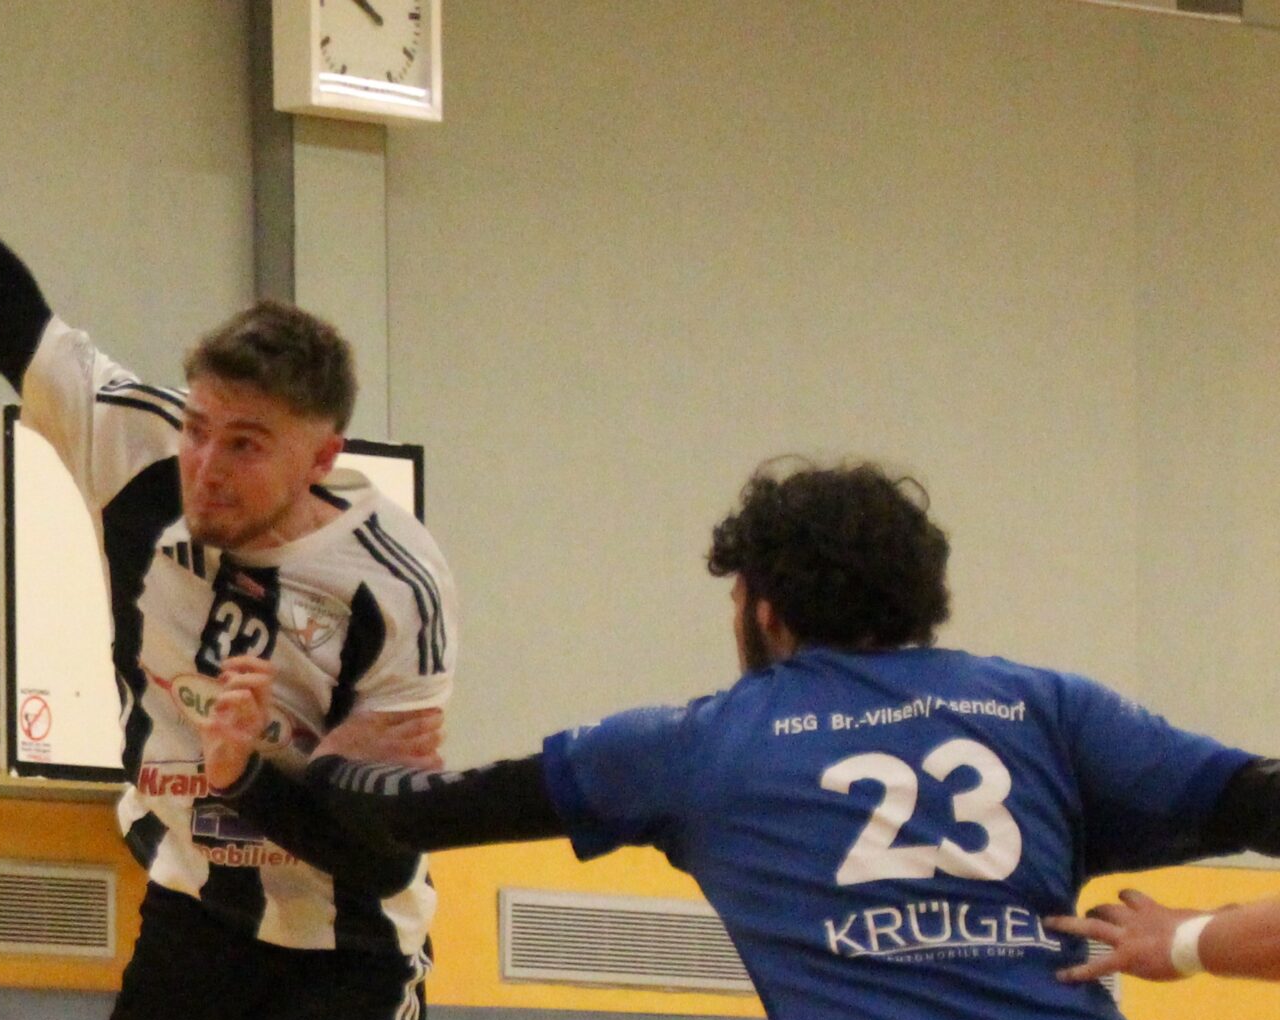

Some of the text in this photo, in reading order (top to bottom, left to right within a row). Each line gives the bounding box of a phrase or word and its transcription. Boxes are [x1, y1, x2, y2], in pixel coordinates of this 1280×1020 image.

[774, 714, 818, 736] HSG
[138, 767, 208, 797] Kran
[820, 737, 1023, 887] 23
